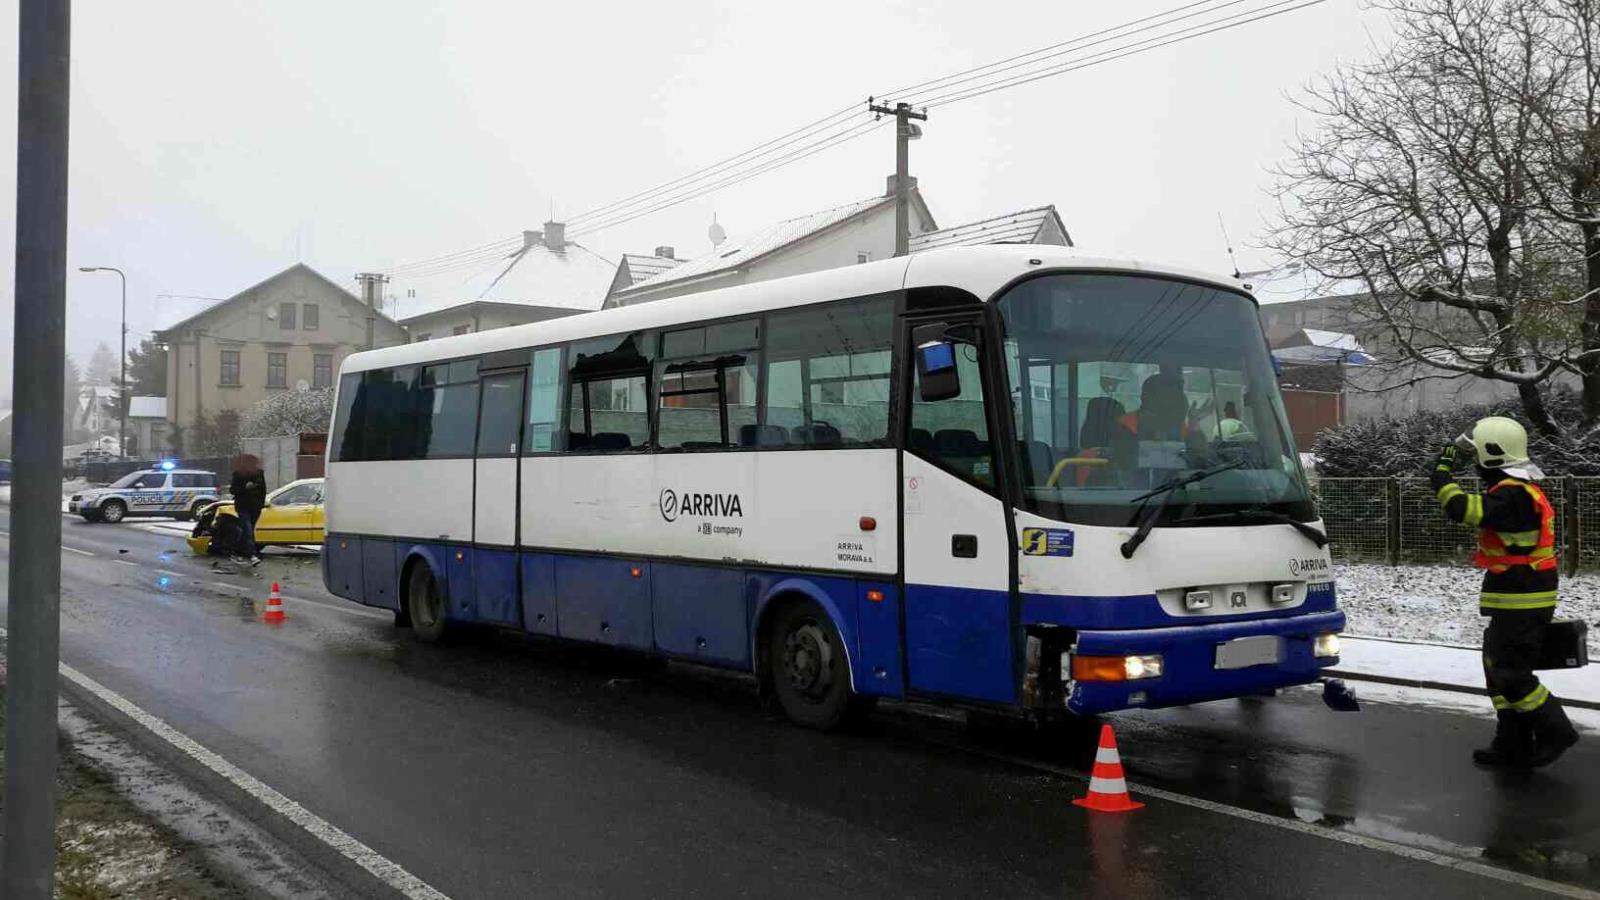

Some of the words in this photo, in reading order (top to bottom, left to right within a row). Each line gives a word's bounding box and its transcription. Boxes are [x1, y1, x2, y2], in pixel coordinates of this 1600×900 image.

[680, 493, 743, 517] ARRIVA
[713, 526, 743, 537] company
[1300, 559, 1329, 571] ARRIVA
